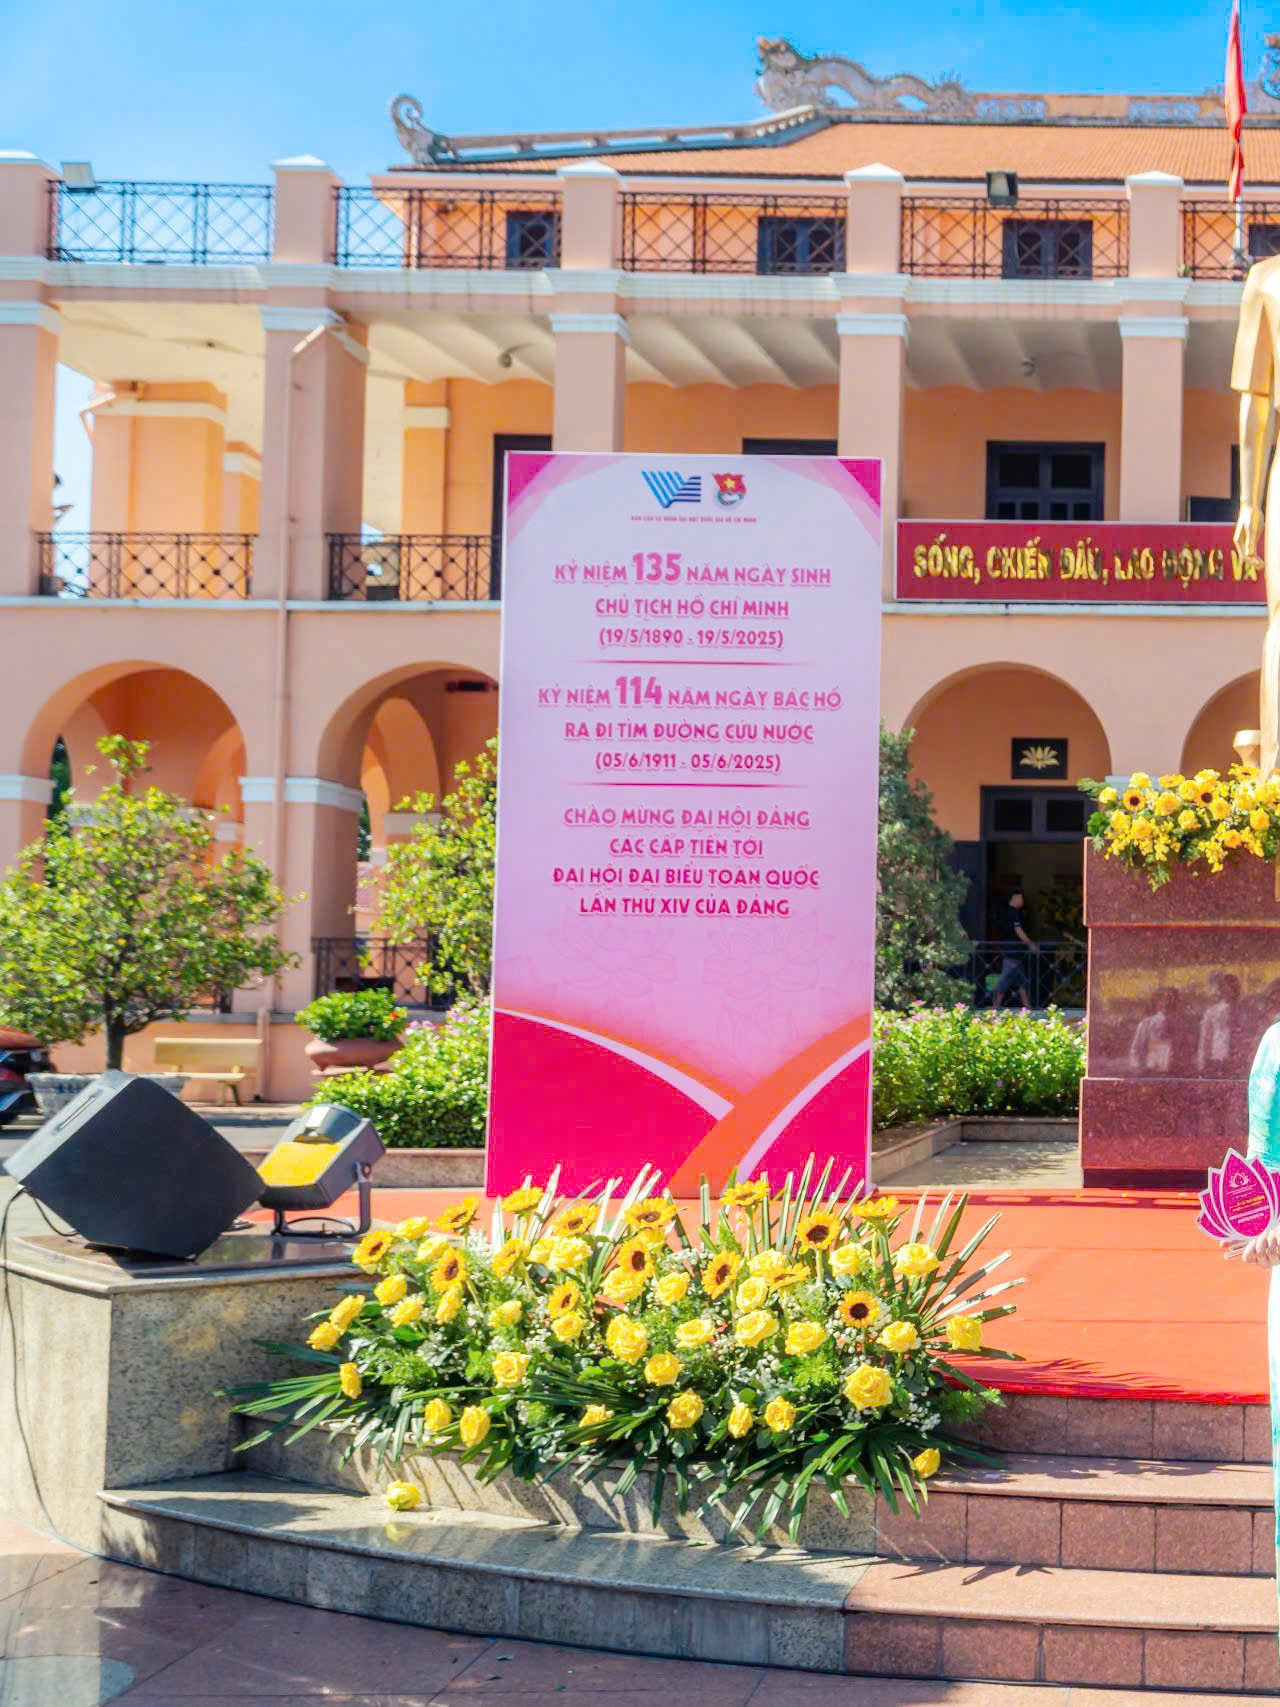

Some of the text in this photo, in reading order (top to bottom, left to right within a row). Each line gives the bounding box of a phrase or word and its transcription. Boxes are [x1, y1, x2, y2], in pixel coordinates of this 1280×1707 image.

[583, 561, 627, 588] NIỆM
[631, 553, 682, 581] 135
[687, 563, 729, 583] NĂM
[734, 564, 786, 583] NGÀY
[790, 568, 831, 584] SINH
[914, 533, 981, 584] SỐNG,
[986, 536, 1052, 581] CHIẾN
[1114, 547, 1154, 581] LAO
[595, 593, 789, 621] CHỦ TỊCH HỒ CHÍ MINH
[599, 628, 683, 646] (19/5/1890
[697, 629, 784, 649] 19/5/2025)
[567, 685, 610, 711] NIỆM
[615, 676, 662, 705] 114
[668, 685, 710, 706] NĂM
[716, 686, 767, 706] NGÀY
[773, 687, 809, 707] BÁC
[814, 685, 842, 708] HỒ
[564, 722, 589, 738] RA
[595, 722, 612, 738] ĐI
[618, 719, 647, 739] TÌM
[654, 719, 719, 740] ĐƯỜNG
[595, 752, 676, 771] (05/6/1911
[690, 753, 781, 773] 05/6/2025)
[564, 805, 809, 832] CHÀO MỪNG ĐẠI HỘI ĐẢNG
[553, 861, 819, 890] ĐẠI HỘI ĐẠI BIỂU TOÀN QUỐC
[622, 895, 655, 914] THỨ
[660, 898, 690, 914] XIV
[695, 893, 730, 915] CỦA
[736, 894, 789, 916] ĐẢNG
